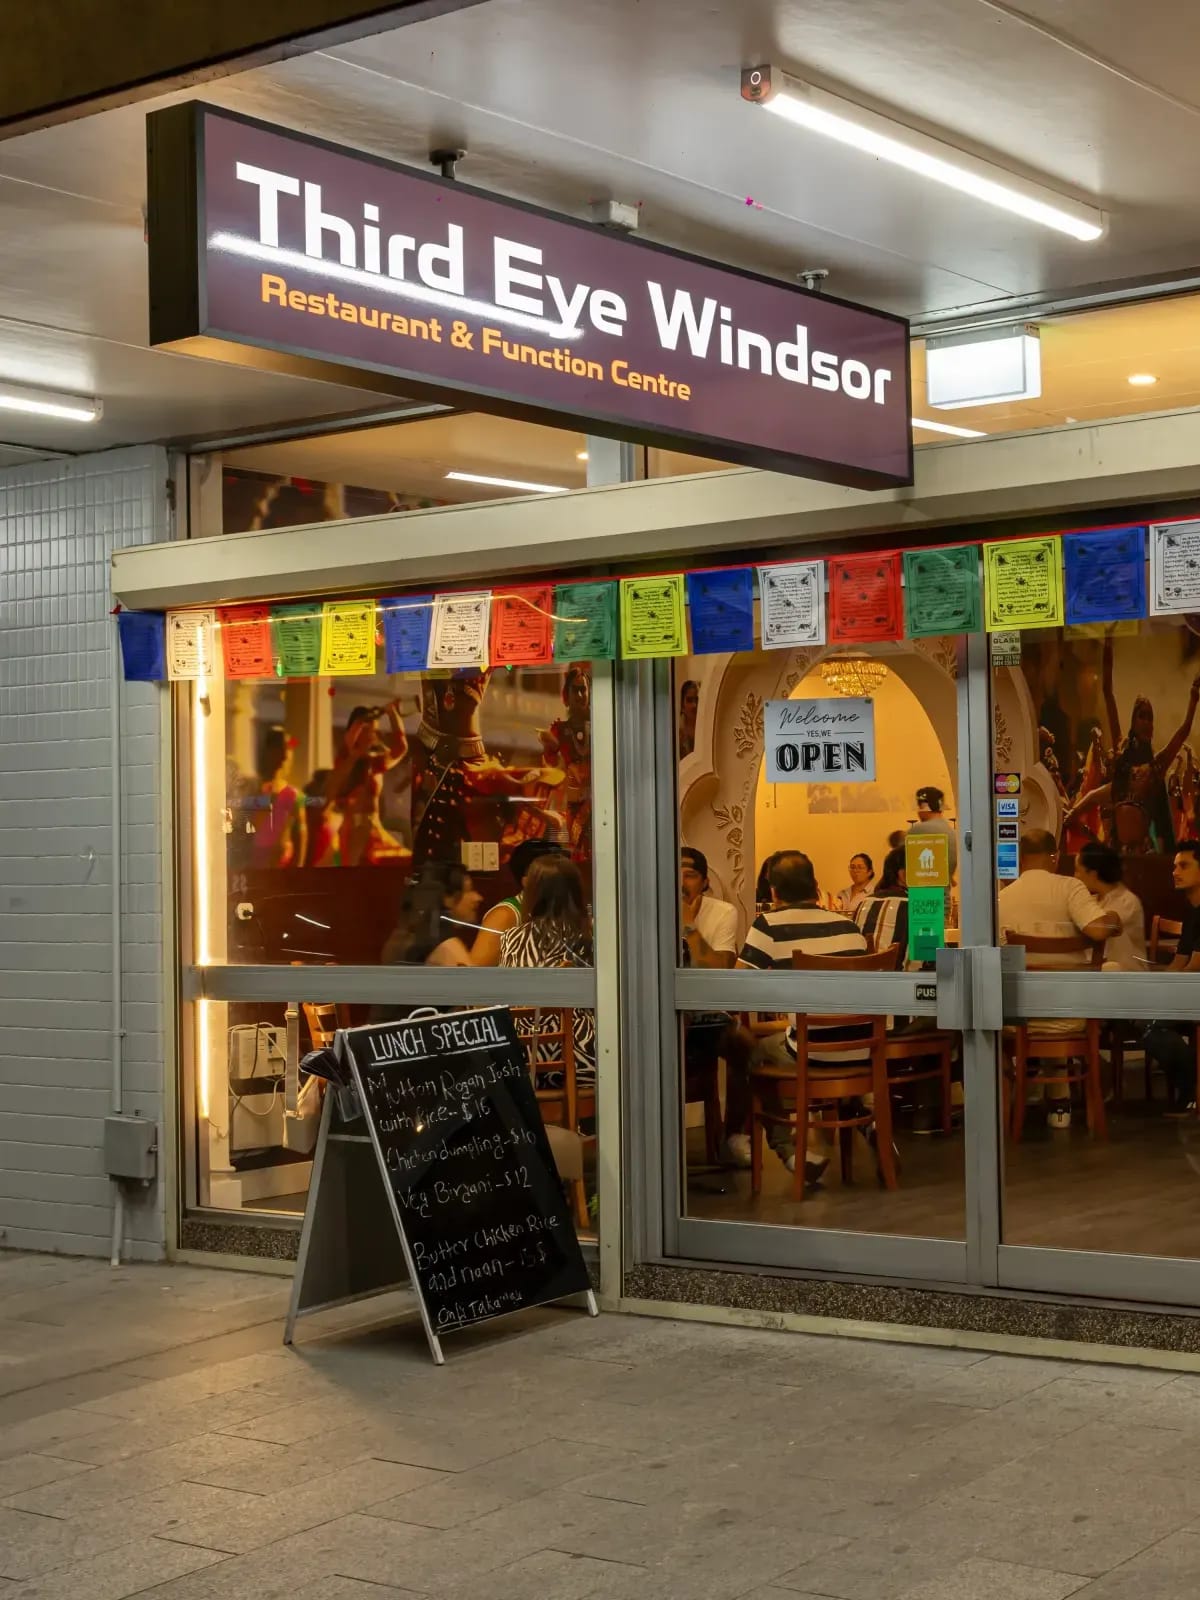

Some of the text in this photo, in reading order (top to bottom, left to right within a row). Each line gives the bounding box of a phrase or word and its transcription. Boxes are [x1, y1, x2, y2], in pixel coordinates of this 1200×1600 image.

[235, 161, 892, 404] Third Eye Windsor
[260, 272, 692, 402] Restaurant & Function Centre
[779, 705, 861, 729] Welcome
[775, 741, 867, 773] OPEN
[1000, 802, 1017, 810] VISA
[917, 987, 937, 999] PUS
[369, 1015, 507, 1061] LUNCH SPECIAL
[440, 1070, 486, 1101] Rogan
[486, 1059, 521, 1084] Josh
[379, 1111, 415, 1132] with
[440, 1133, 505, 1160] dumpling
[397, 1186, 432, 1218] Veg
[413, 1214, 560, 1271] Butter Chicken Rice
[428, 1266, 457, 1291] and
[461, 1258, 504, 1283] naan
